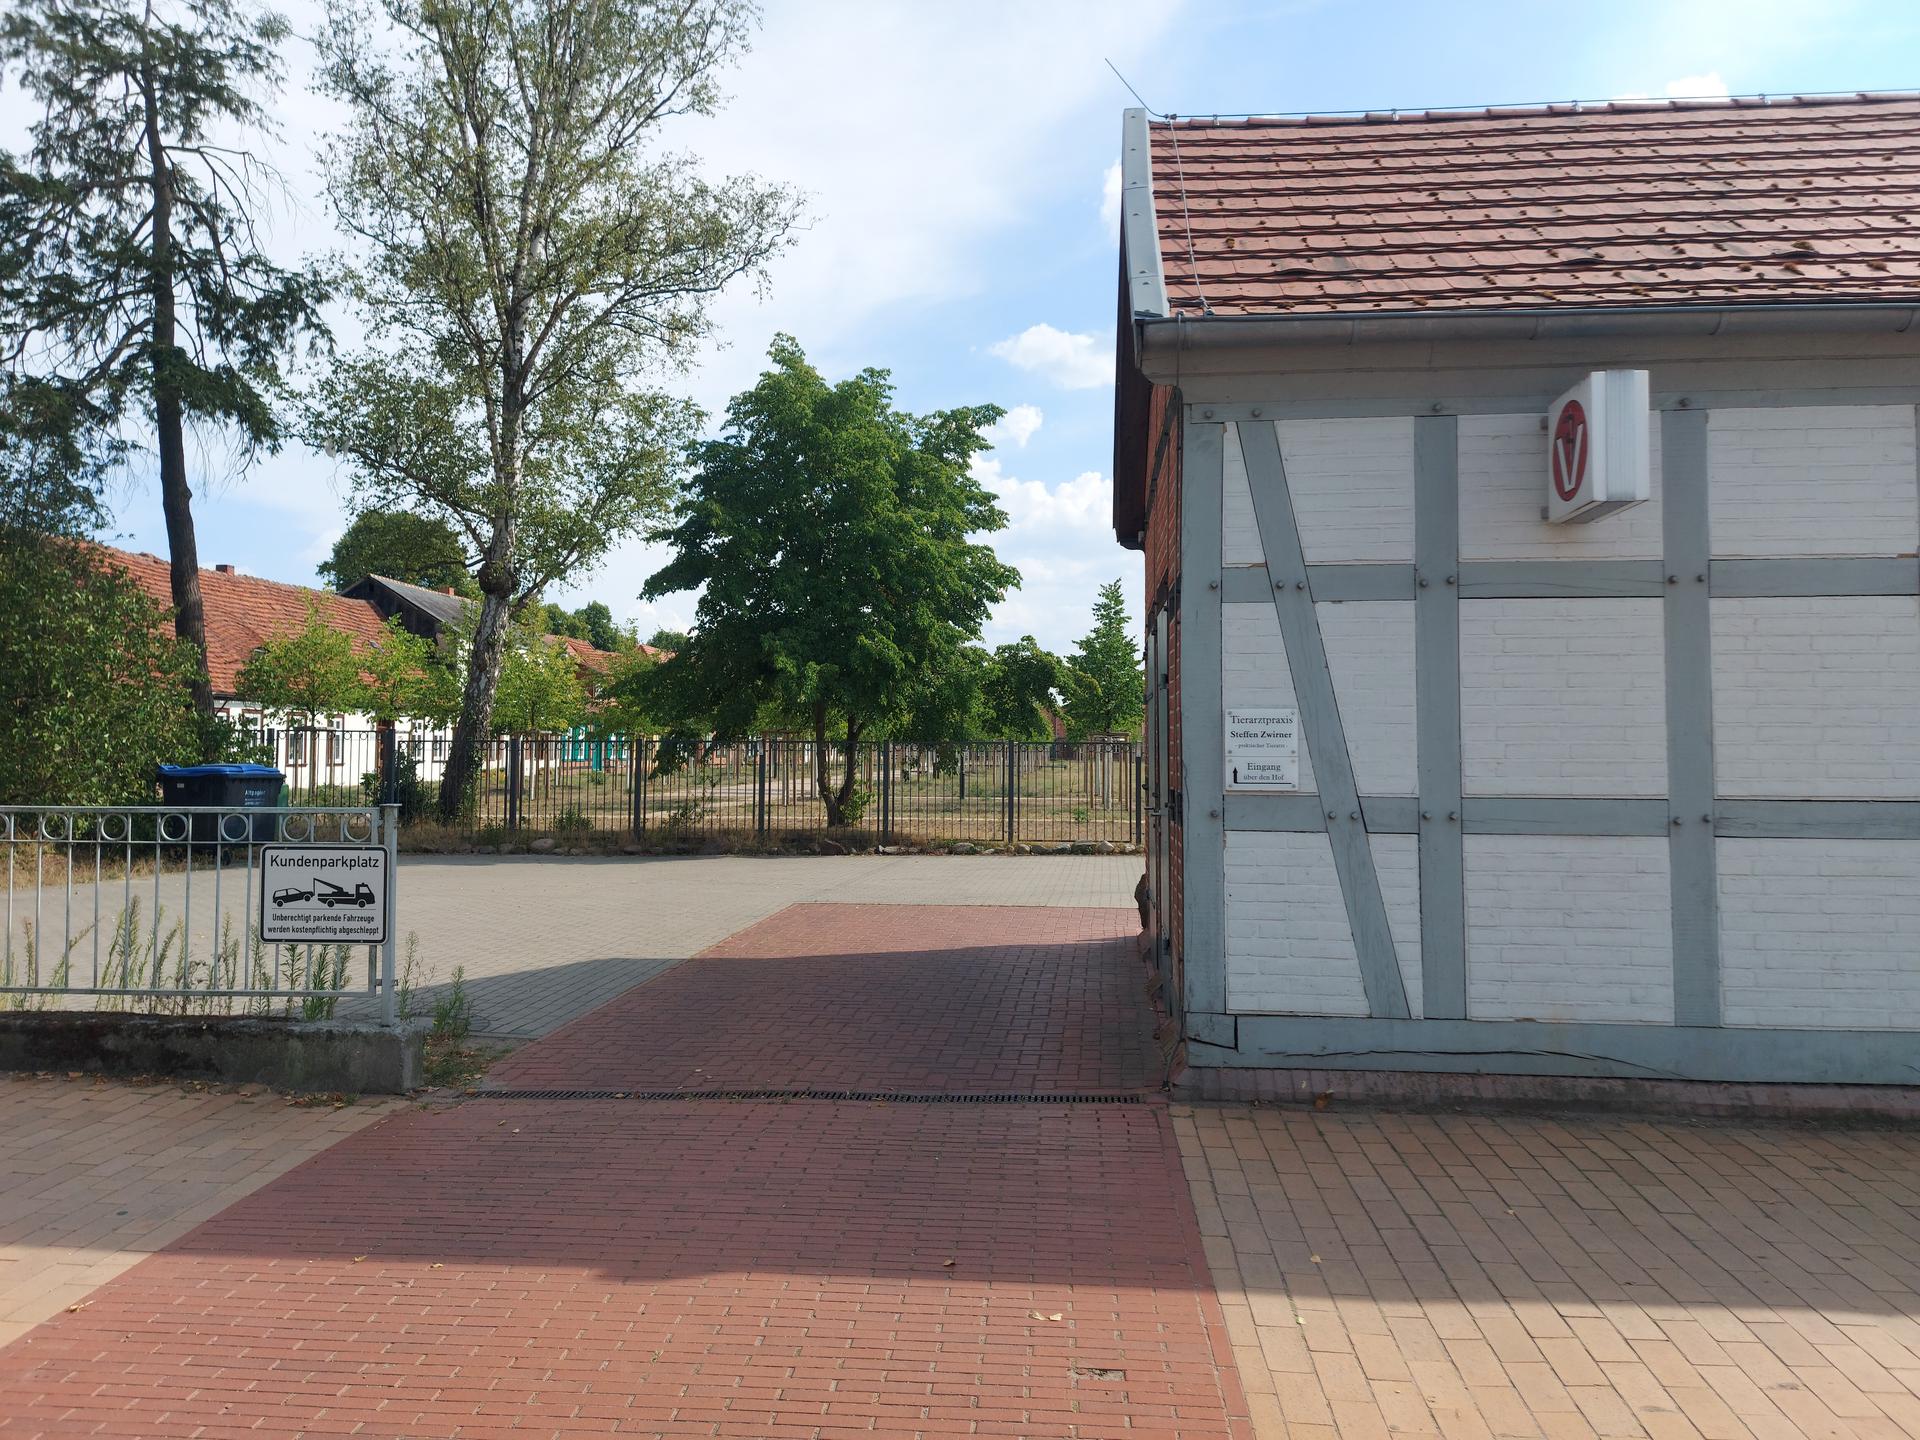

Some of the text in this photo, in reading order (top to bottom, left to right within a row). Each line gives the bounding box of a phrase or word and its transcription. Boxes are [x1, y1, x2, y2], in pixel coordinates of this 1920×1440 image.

[1230, 715, 1293, 725] Tierarztpraxis
[1247, 763, 1281, 771] Eingang
[270, 855, 379, 870] Kundenparkplatz
[272, 913, 374, 923] Unberechtigt parkende Fahrzeuge
[267, 925, 379, 935] werden kostenpflichtig abgeschleppt
